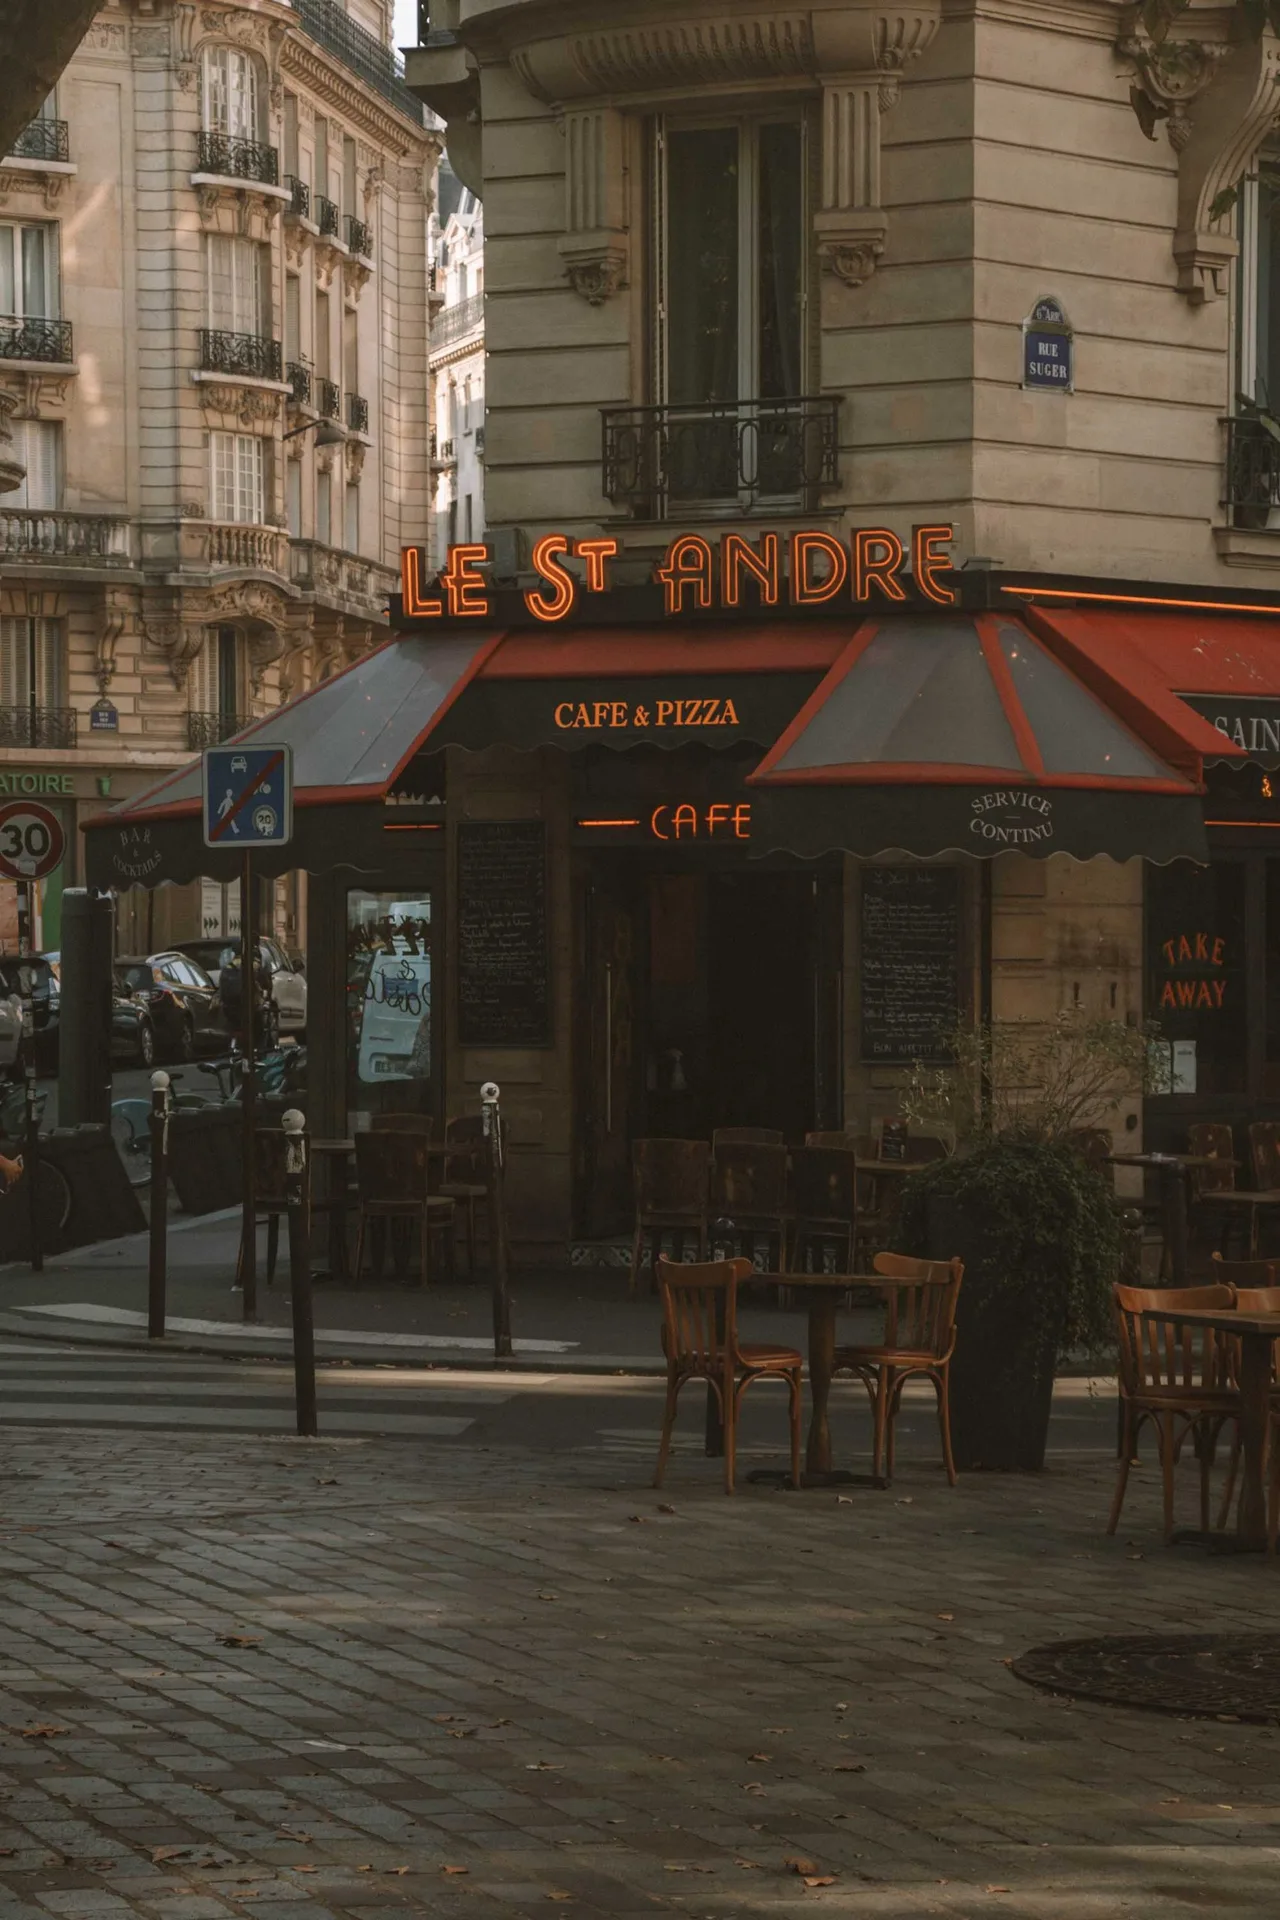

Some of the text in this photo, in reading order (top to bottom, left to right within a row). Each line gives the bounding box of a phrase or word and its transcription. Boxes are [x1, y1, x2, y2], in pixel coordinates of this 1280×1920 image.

[1038, 342, 1058, 357] RUE
[1029, 361, 1067, 379] SUGER
[402, 525, 956, 621] LE ST ANDRE
[554, 699, 739, 728] CAFE & PIZZA
[971, 791, 1052, 816] SERVICE
[651, 804, 751, 839] CAFE
[970, 818, 1053, 843] CONTINU
[0, 823, 49, 858] 30
[120, 827, 151, 847] BAR
[113, 850, 162, 877] COCKTAILS
[1163, 932, 1226, 966] TAKE
[1160, 980, 1227, 1008] AWAY
